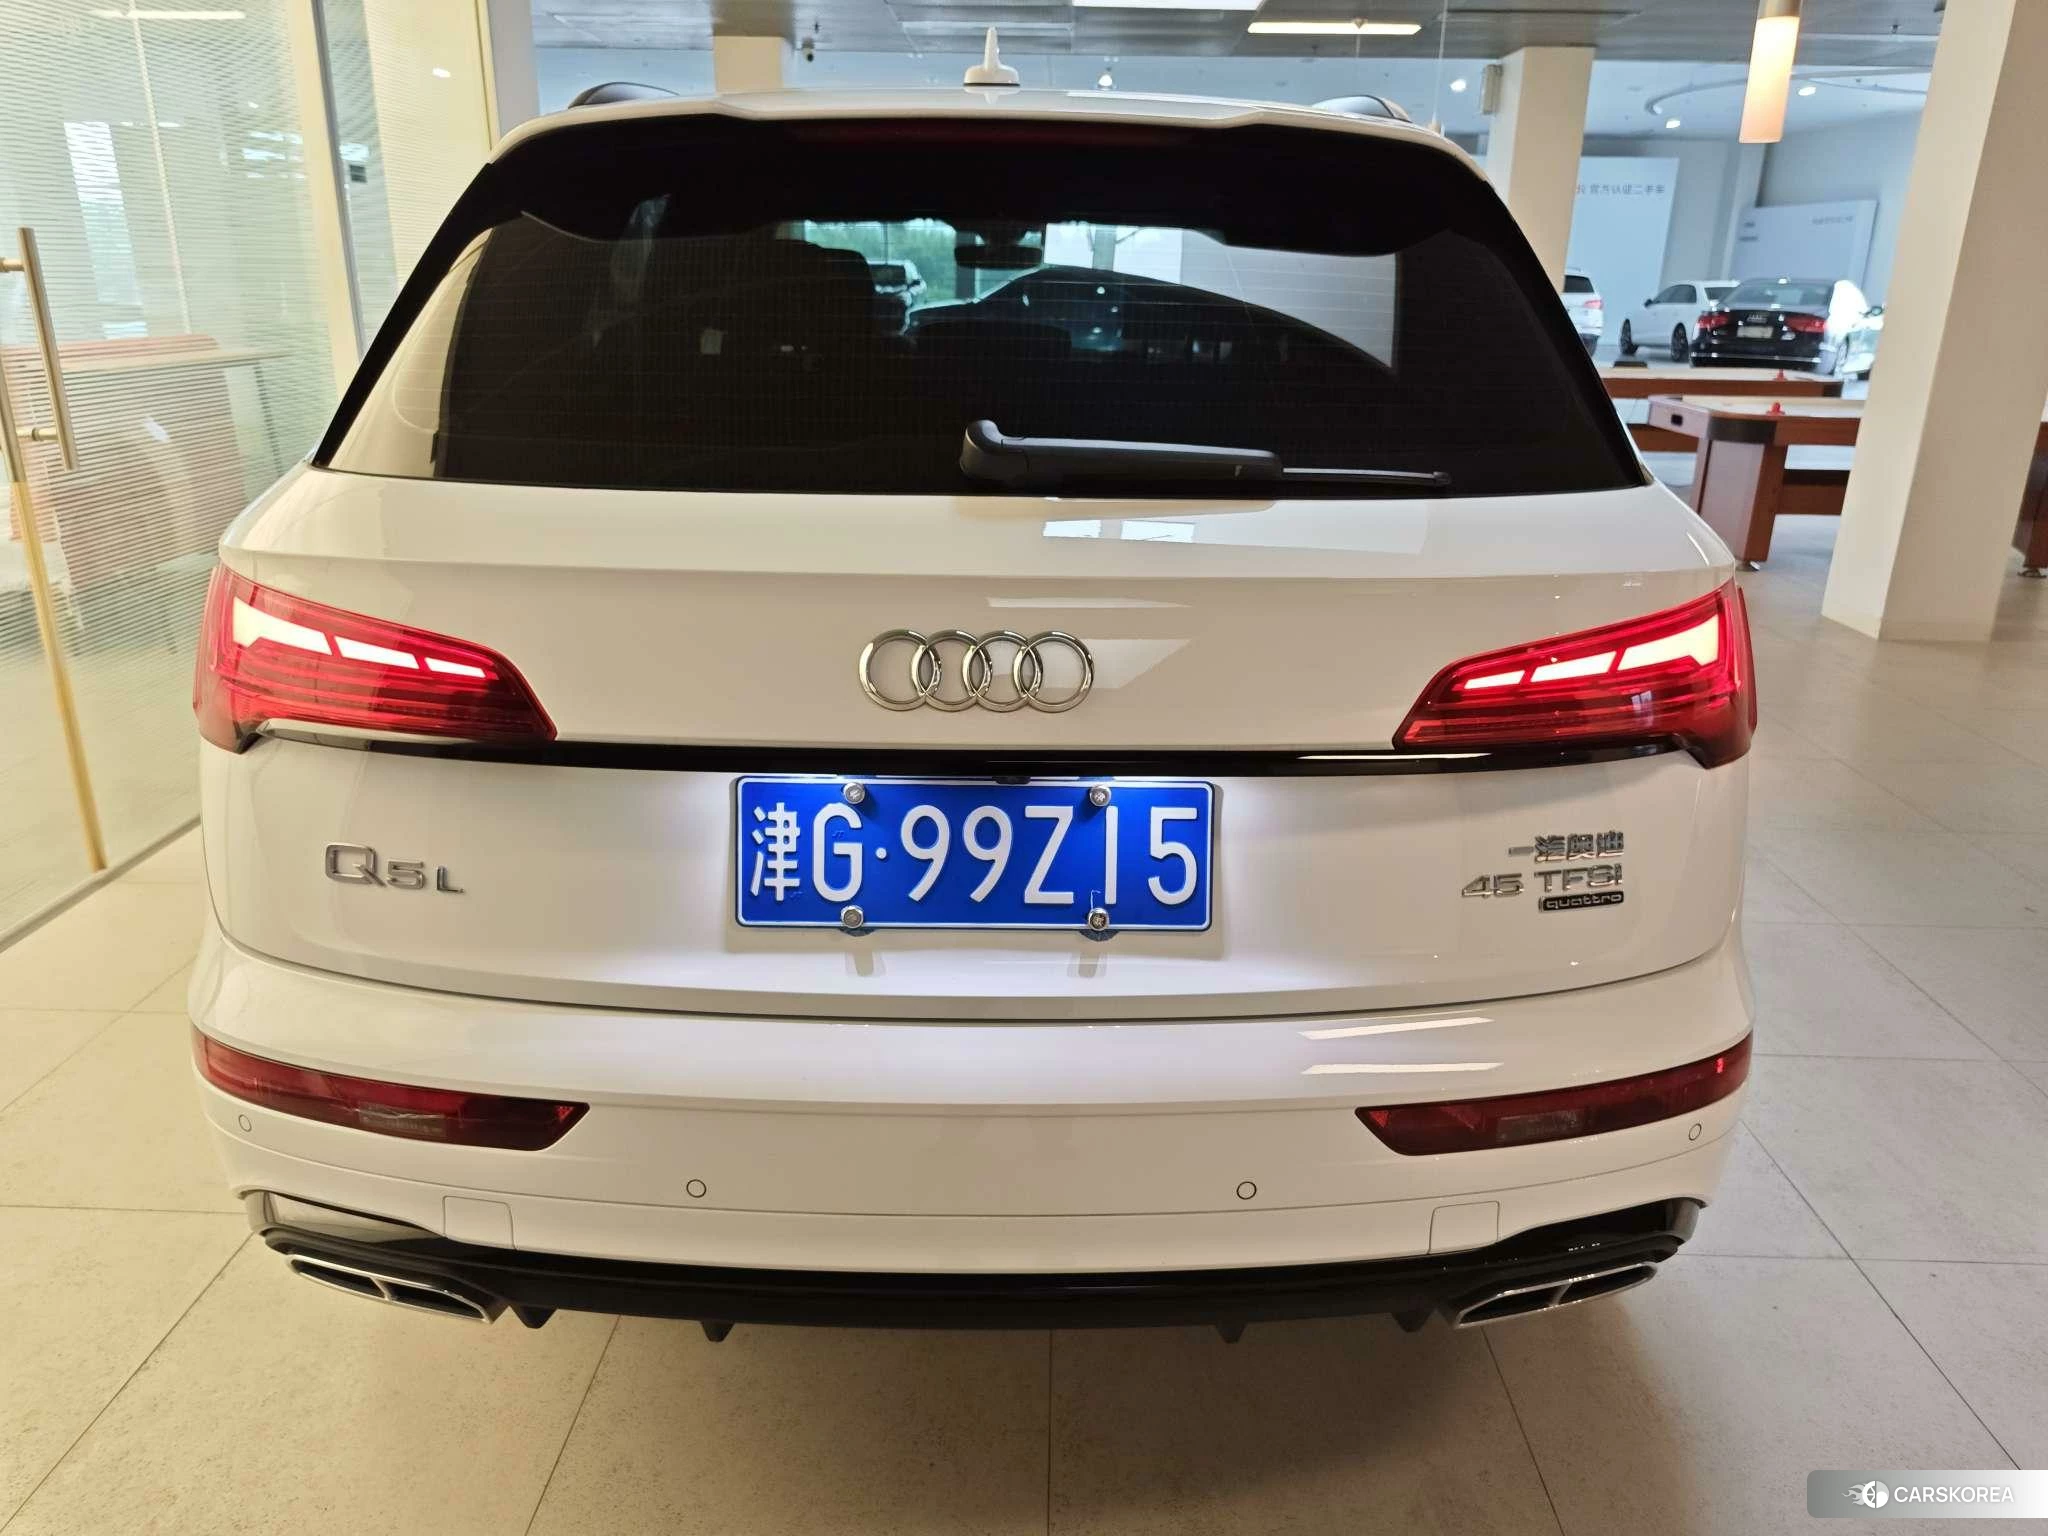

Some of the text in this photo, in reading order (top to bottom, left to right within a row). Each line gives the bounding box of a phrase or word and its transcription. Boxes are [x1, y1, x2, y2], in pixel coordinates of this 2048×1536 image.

[1462, 864, 1622, 899] 45 TFSI
[1546, 893, 1622, 909] quattro
